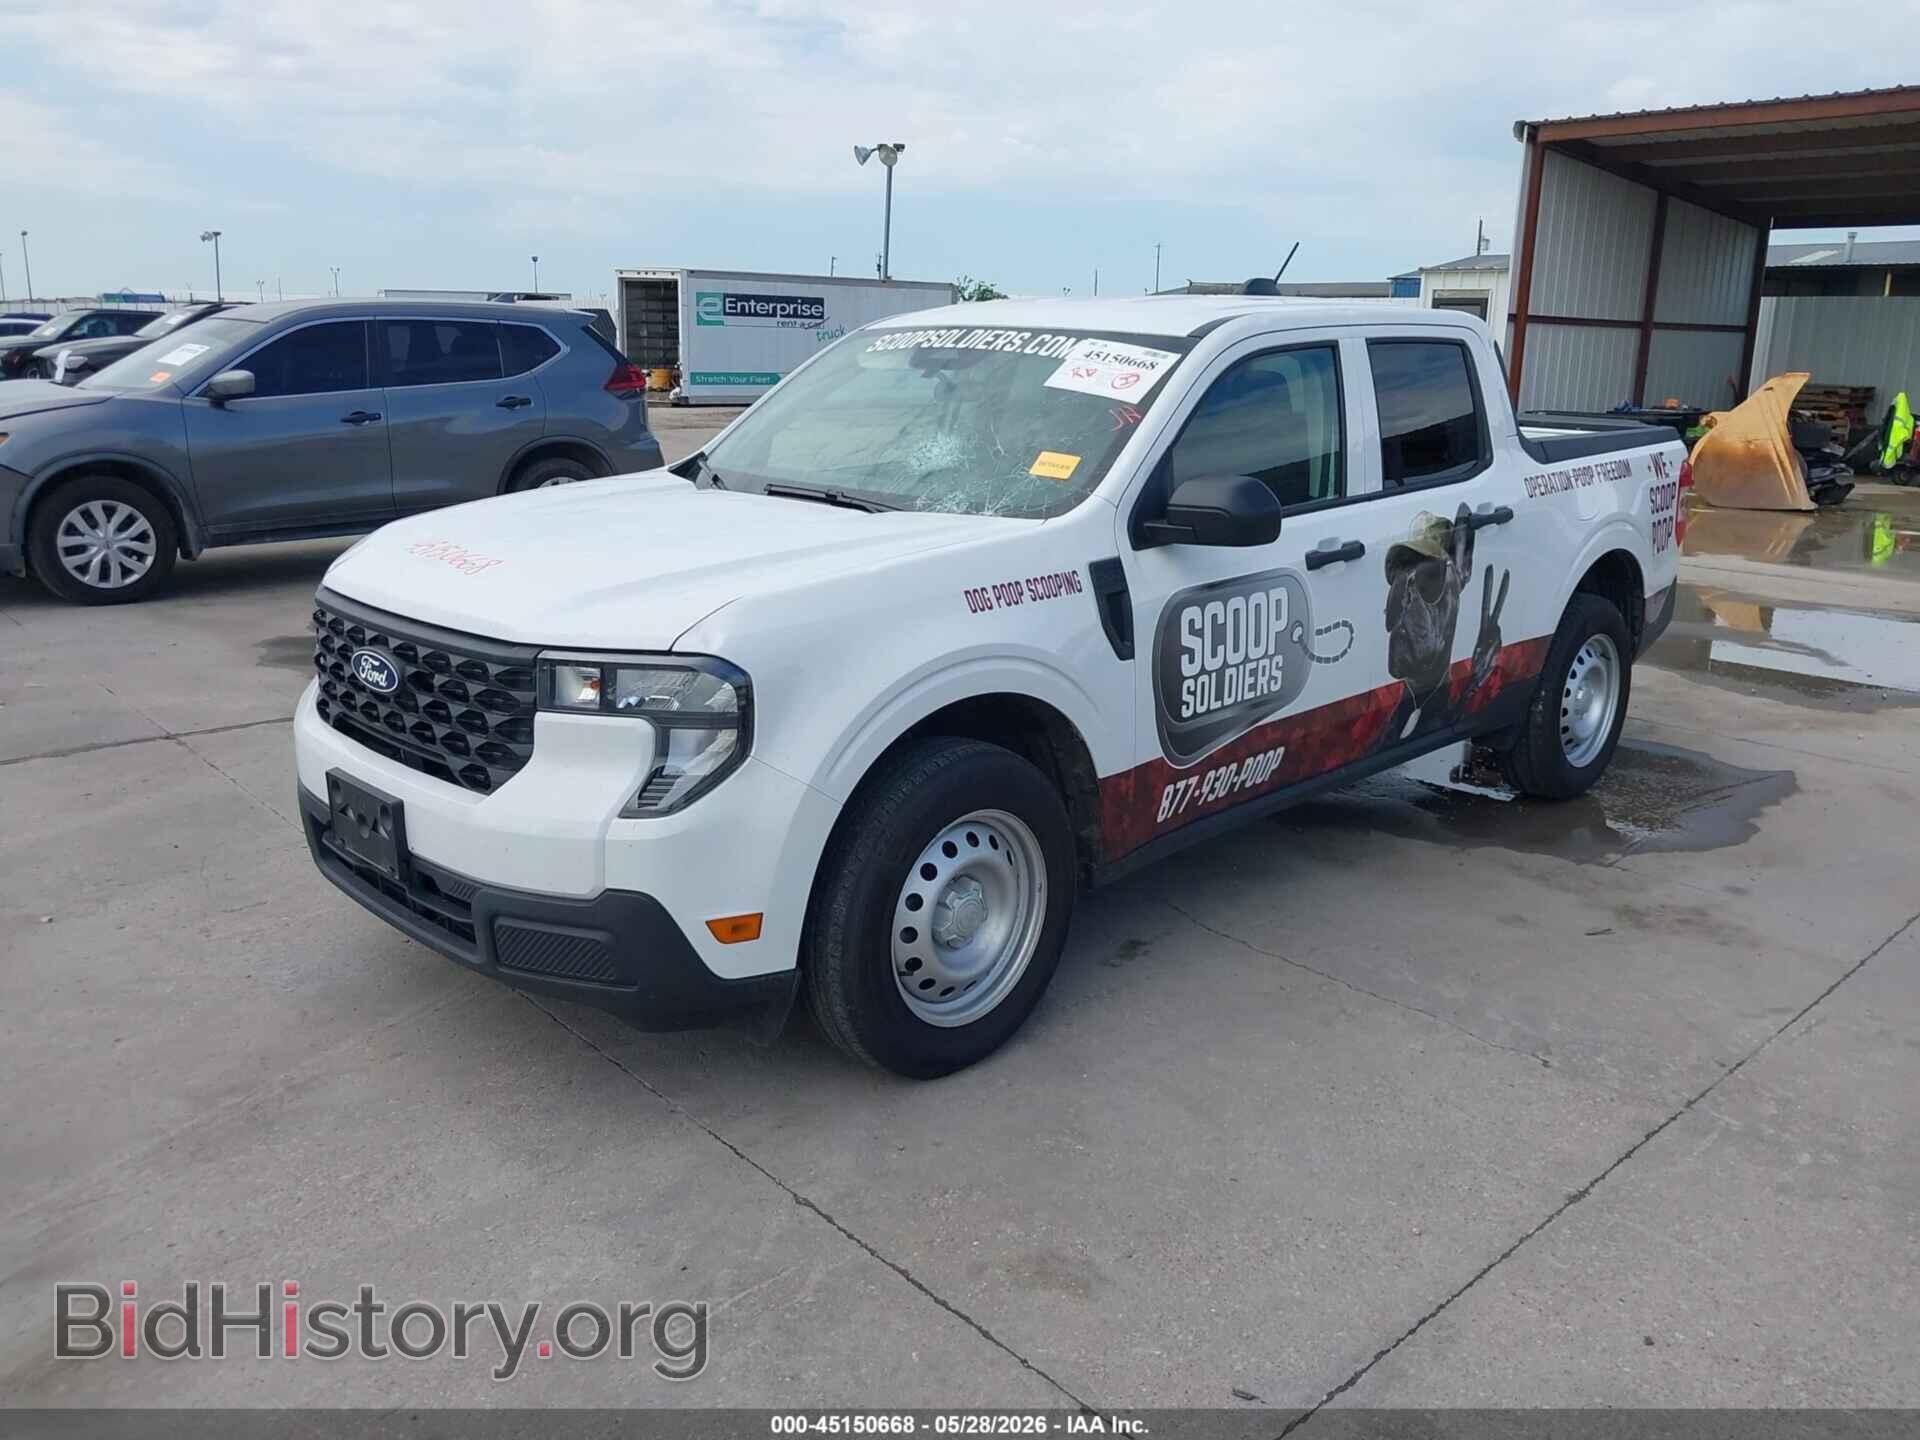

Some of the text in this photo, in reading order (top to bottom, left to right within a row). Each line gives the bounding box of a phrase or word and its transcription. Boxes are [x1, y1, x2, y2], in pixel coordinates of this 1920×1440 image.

[724, 298, 824, 319] Enterprise
[816, 324, 847, 342] truck
[695, 375, 726, 384] Stretch
[729, 376, 748, 384] Your
[1523, 458, 1632, 498] OPERATION POOP FREEDOM
[1649, 452, 1670, 479] WE
[1649, 481, 1677, 515] SCOOP
[1651, 516, 1674, 556] POOP
[963, 569, 1083, 614] DOG POOP SCOOPING
[1180, 587, 1289, 677] SCOOP
[360, 655, 388, 687] Ford
[1181, 655, 1284, 718] SOLDIERS
[1156, 746, 1286, 824] 877-930-POOP
